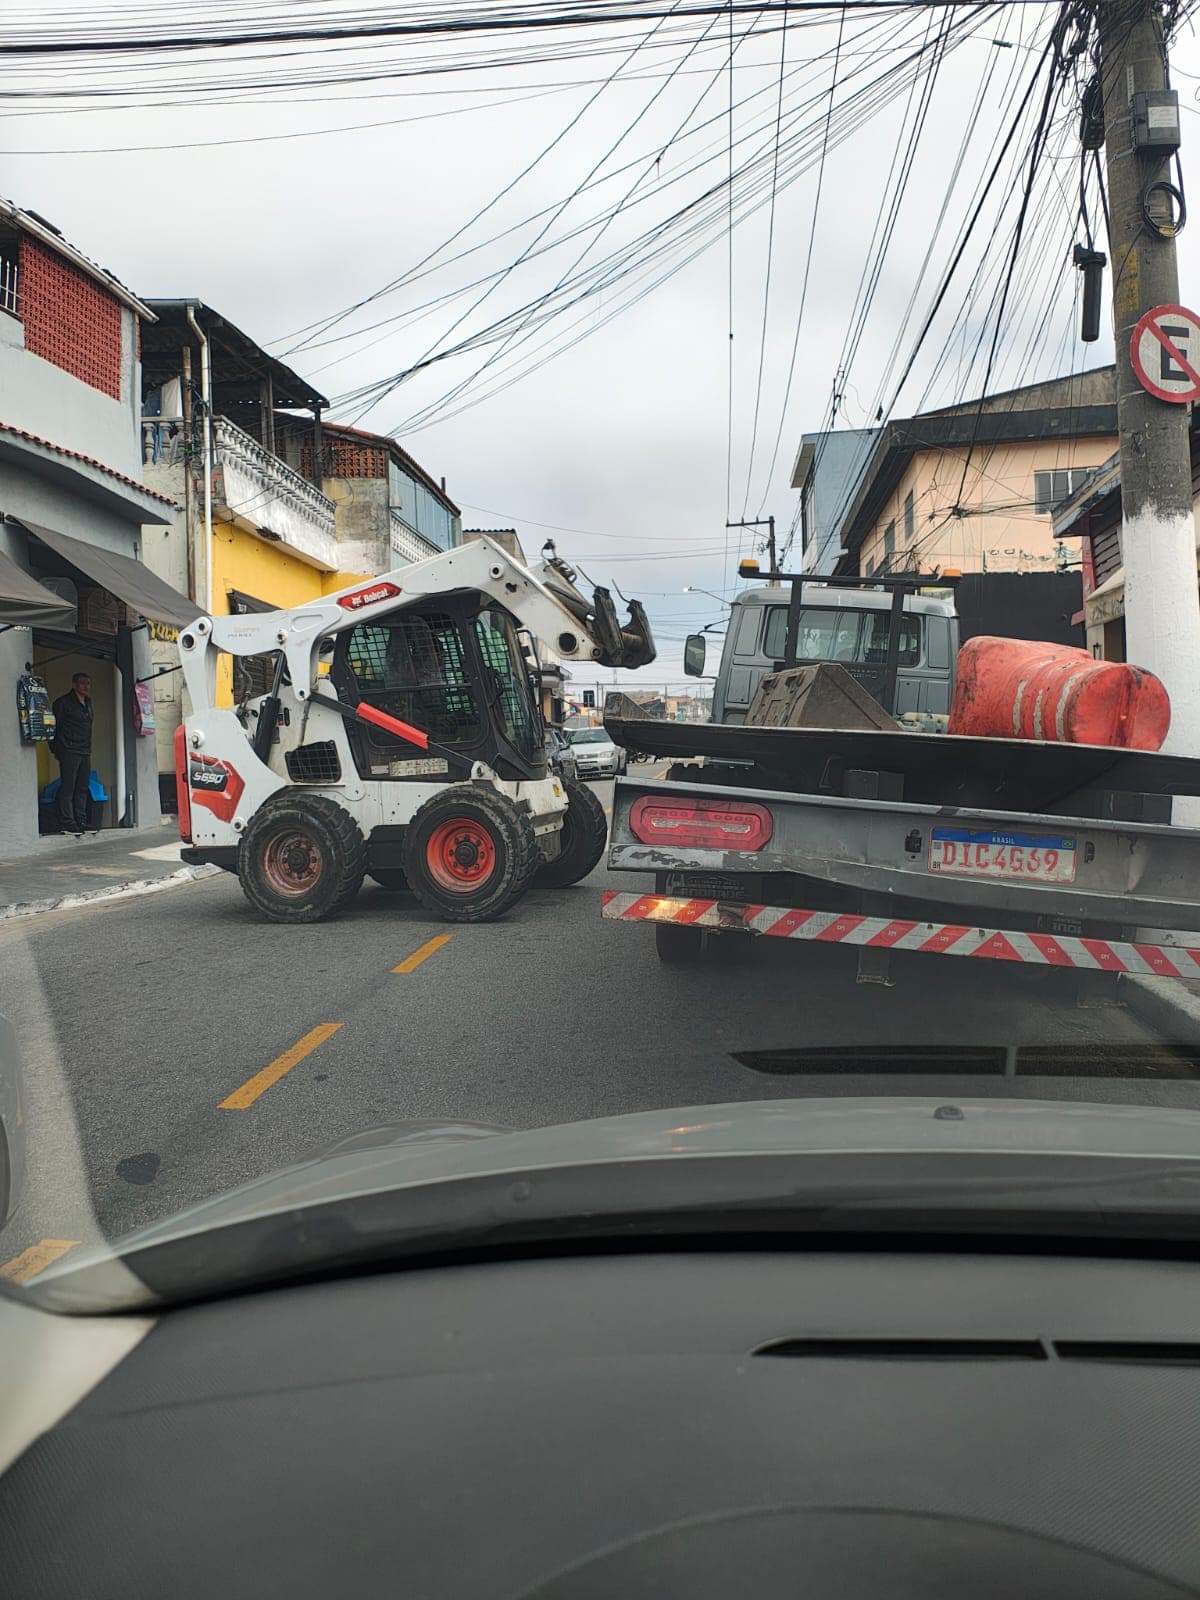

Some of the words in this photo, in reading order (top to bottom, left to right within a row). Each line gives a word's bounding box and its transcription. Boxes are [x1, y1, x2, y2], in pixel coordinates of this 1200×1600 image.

[1160, 325, 1190, 382] E
[363, 588, 389, 604] Bobcat
[991, 836, 1015, 845] BRASIL
[942, 841, 1059, 873] DIC4G69
